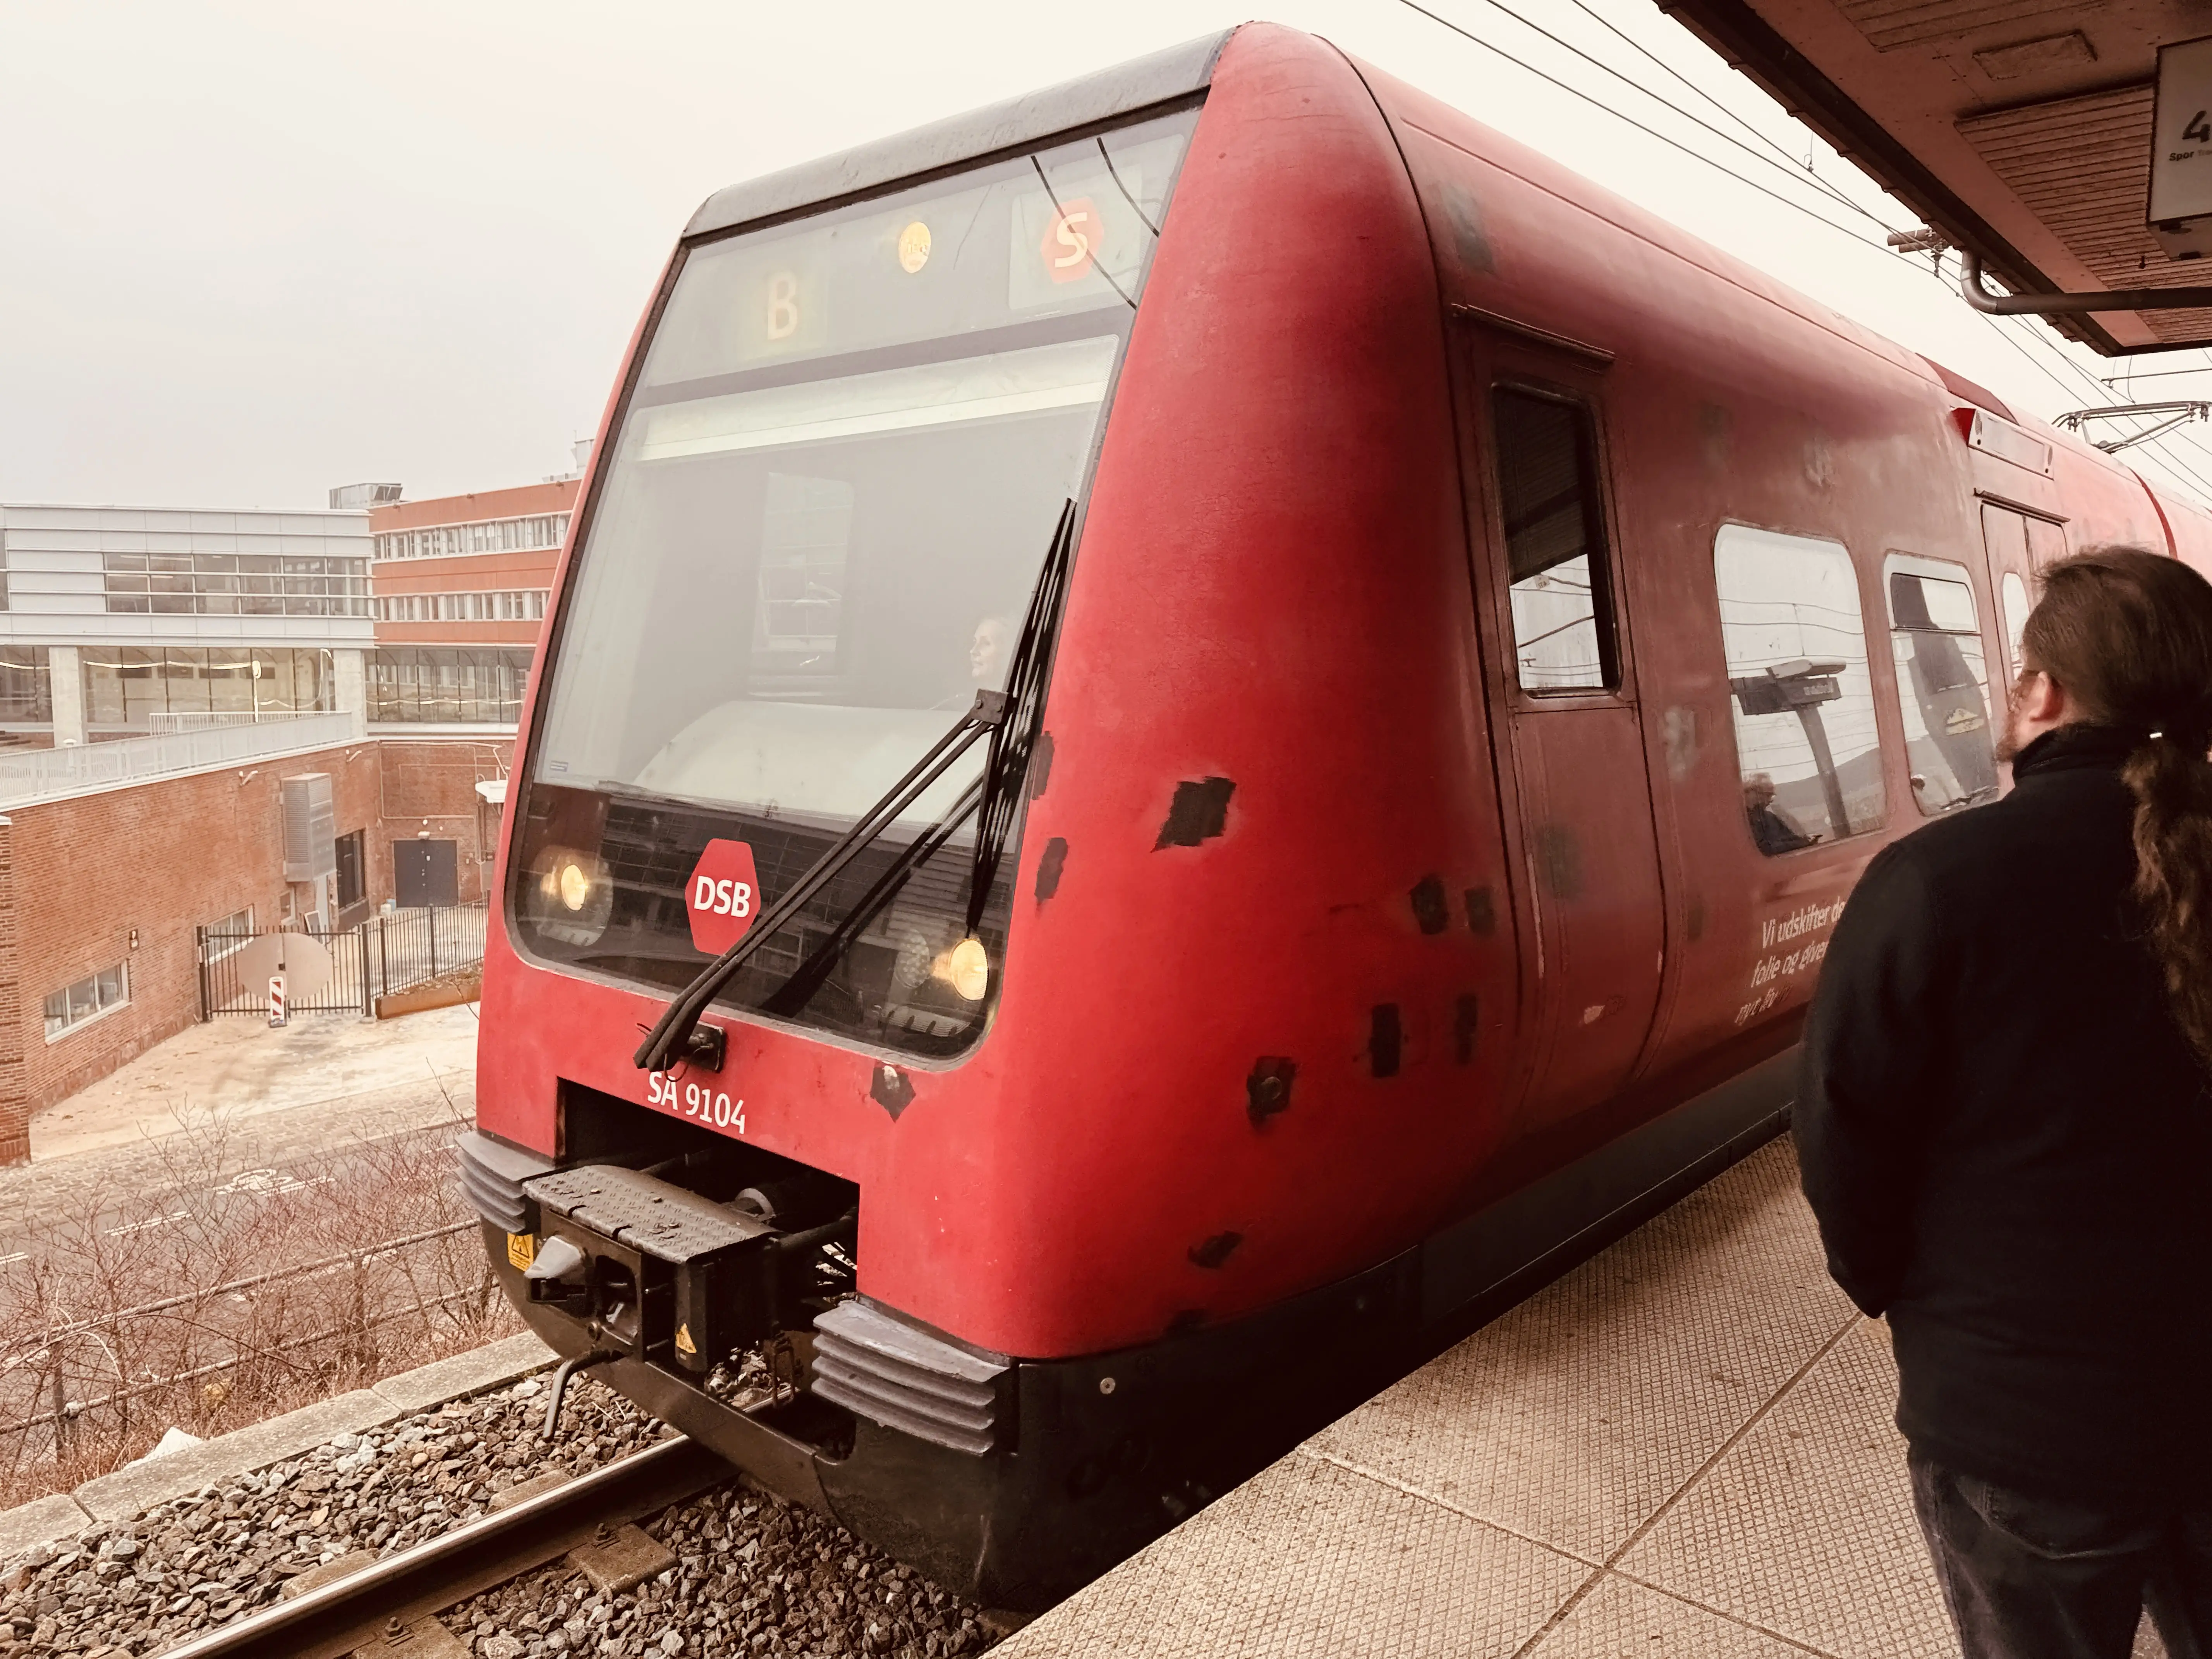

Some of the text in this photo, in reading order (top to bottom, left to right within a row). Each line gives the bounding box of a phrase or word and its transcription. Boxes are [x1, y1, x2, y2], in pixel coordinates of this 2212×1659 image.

[2182, 110, 2210, 143] 4
[2169, 151, 2195, 161] Spor
[1054, 212, 1088, 268] S
[768, 270, 797, 340] B
[694, 875, 751, 918] DSB
[1763, 919, 1776, 948] Vi
[1778, 904, 1831, 943] udskifter
[1751, 955, 1781, 988] folie
[1782, 950, 1801, 974] og
[647, 1071, 745, 1134] SA 9104
